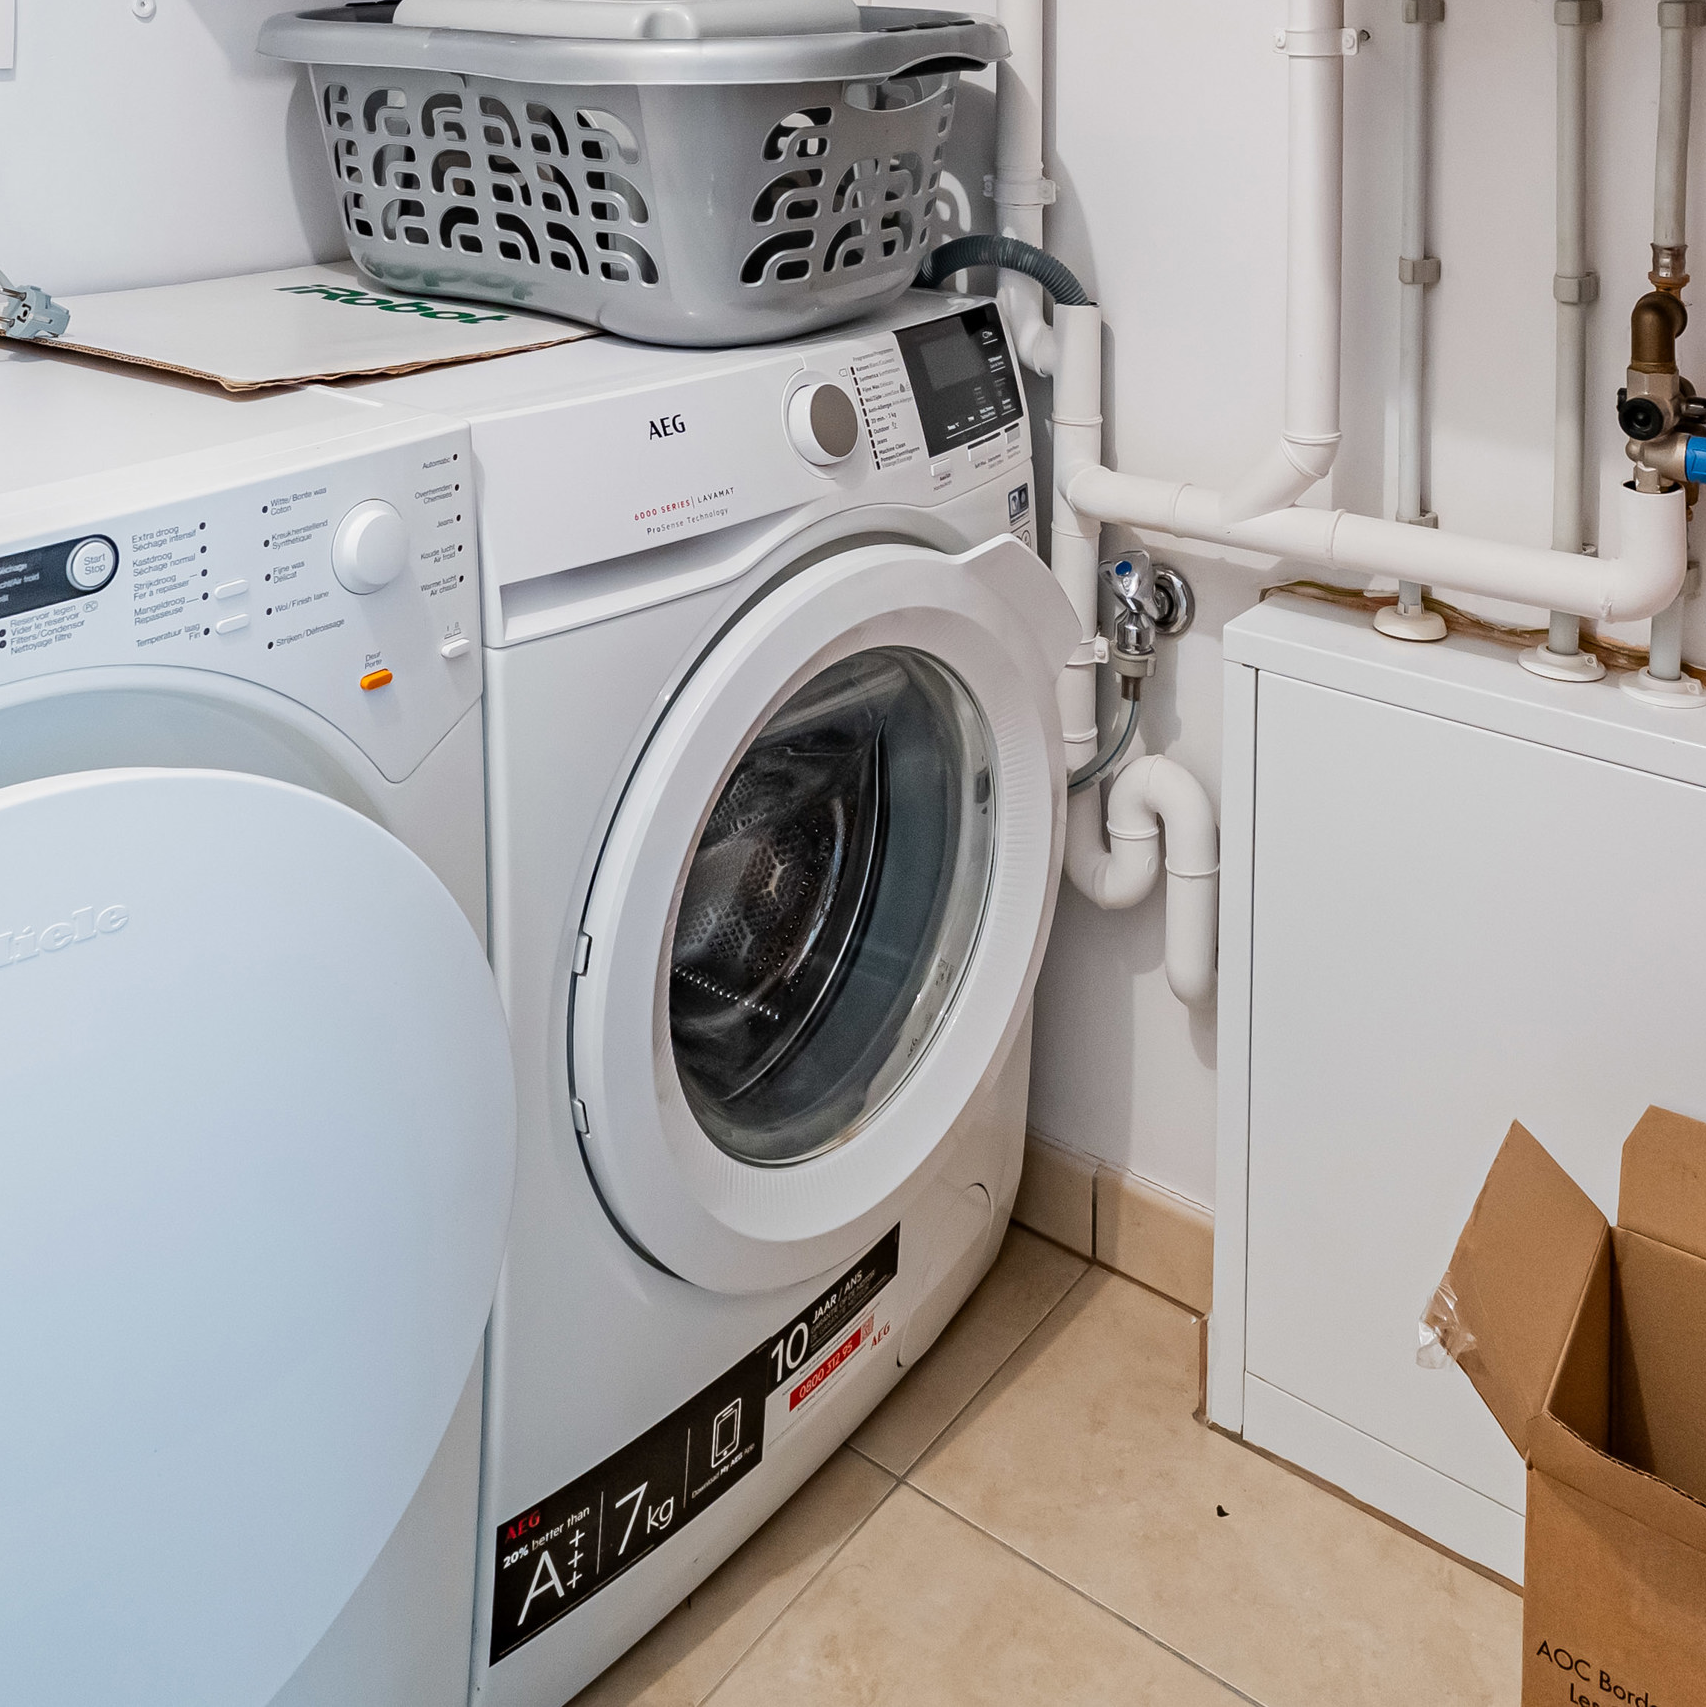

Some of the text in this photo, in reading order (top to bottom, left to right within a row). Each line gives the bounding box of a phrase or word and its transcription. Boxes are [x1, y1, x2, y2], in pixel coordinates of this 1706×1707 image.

[649, 414, 686, 440] AEG
[873, 425, 890, 435] Outdoor
[313, 487, 327, 496] was
[414, 482, 453, 501] Overhemden
[423, 491, 453, 505] Chemises
[270, 505, 292, 516] Coton
[634, 487, 734, 521] 6000 SERIES LAVAMAT
[436, 517, 454, 529] Jeans
[647, 507, 729, 535] ProSense Technology
[131, 526, 180, 544] Extra droog
[169, 529, 197, 543] intensif
[83, 552, 106, 566] Start
[133, 552, 173, 568] Kastdroog
[169, 553, 196, 566] normal
[420, 543, 456, 561] Koude lucht
[433, 550, 456, 564] Air froid
[84, 562, 106, 577] Stop
[291, 560, 305, 570] was
[133, 579, 190, 602] Fer repasser
[420, 574, 457, 593] Warme lucht
[429, 582, 458, 597] Air chaud
[46, 603, 77, 619] legen
[134, 596, 186, 616] Mangeldroog
[134, 606, 184, 626] Repasseuse
[10, 622, 33, 636] Vider
[34, 620, 44, 633] le
[10, 619, 86, 645] Filters/Condensor
[136, 623, 201, 648] Temperatuur laag
[189, 631, 201, 641] Fin
[10, 632, 73, 656] Nettoyage filtre
[364, 658, 383, 670] Porte
[365, 651, 382, 663] Deur
[771, 1321, 809, 1382] 10
[812, 1294, 838, 1324] JAAR
[844, 1269, 863, 1293] ANS
[870, 1320, 891, 1351] AEG
[798, 1341, 853, 1399] 0800 312 95
[691, 1443, 756, 1500] Download My AEG App
[505, 1509, 541, 1543] AEG
[615, 1481, 675, 1557] 7 kg
[503, 1506, 591, 1570] 20% better than
[1536, 1639, 1657, 1707] AOC Bord
